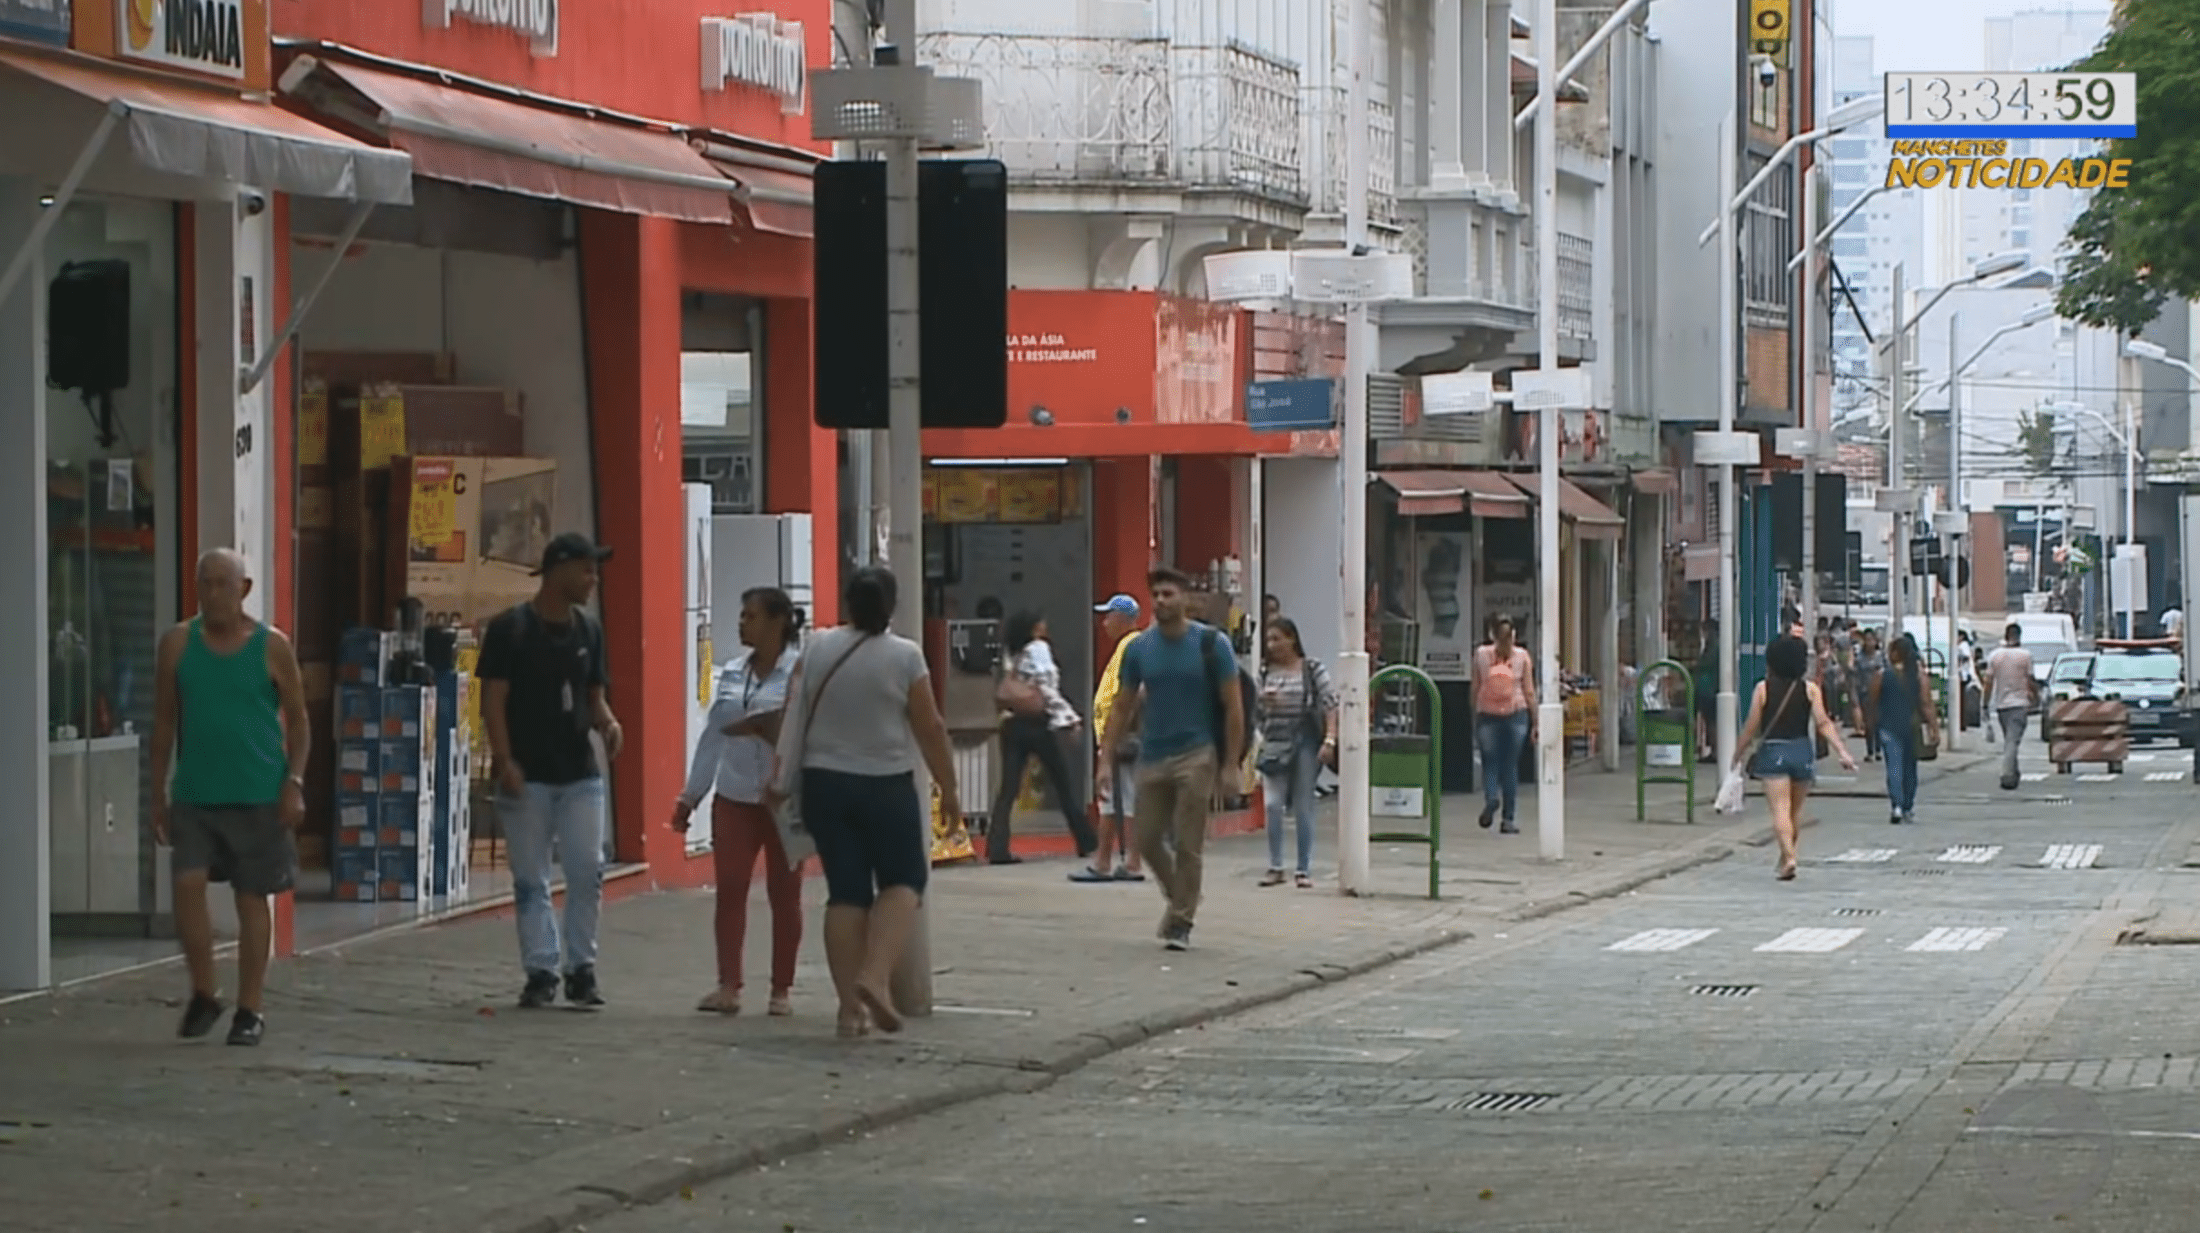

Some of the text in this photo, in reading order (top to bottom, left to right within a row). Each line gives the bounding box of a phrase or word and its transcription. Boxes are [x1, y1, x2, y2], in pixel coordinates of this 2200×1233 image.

[1021, 335, 1037, 346] DA
[1040, 332, 1065, 345] ÁSIA
[1025, 349, 1097, 361] RESTAURANTE
